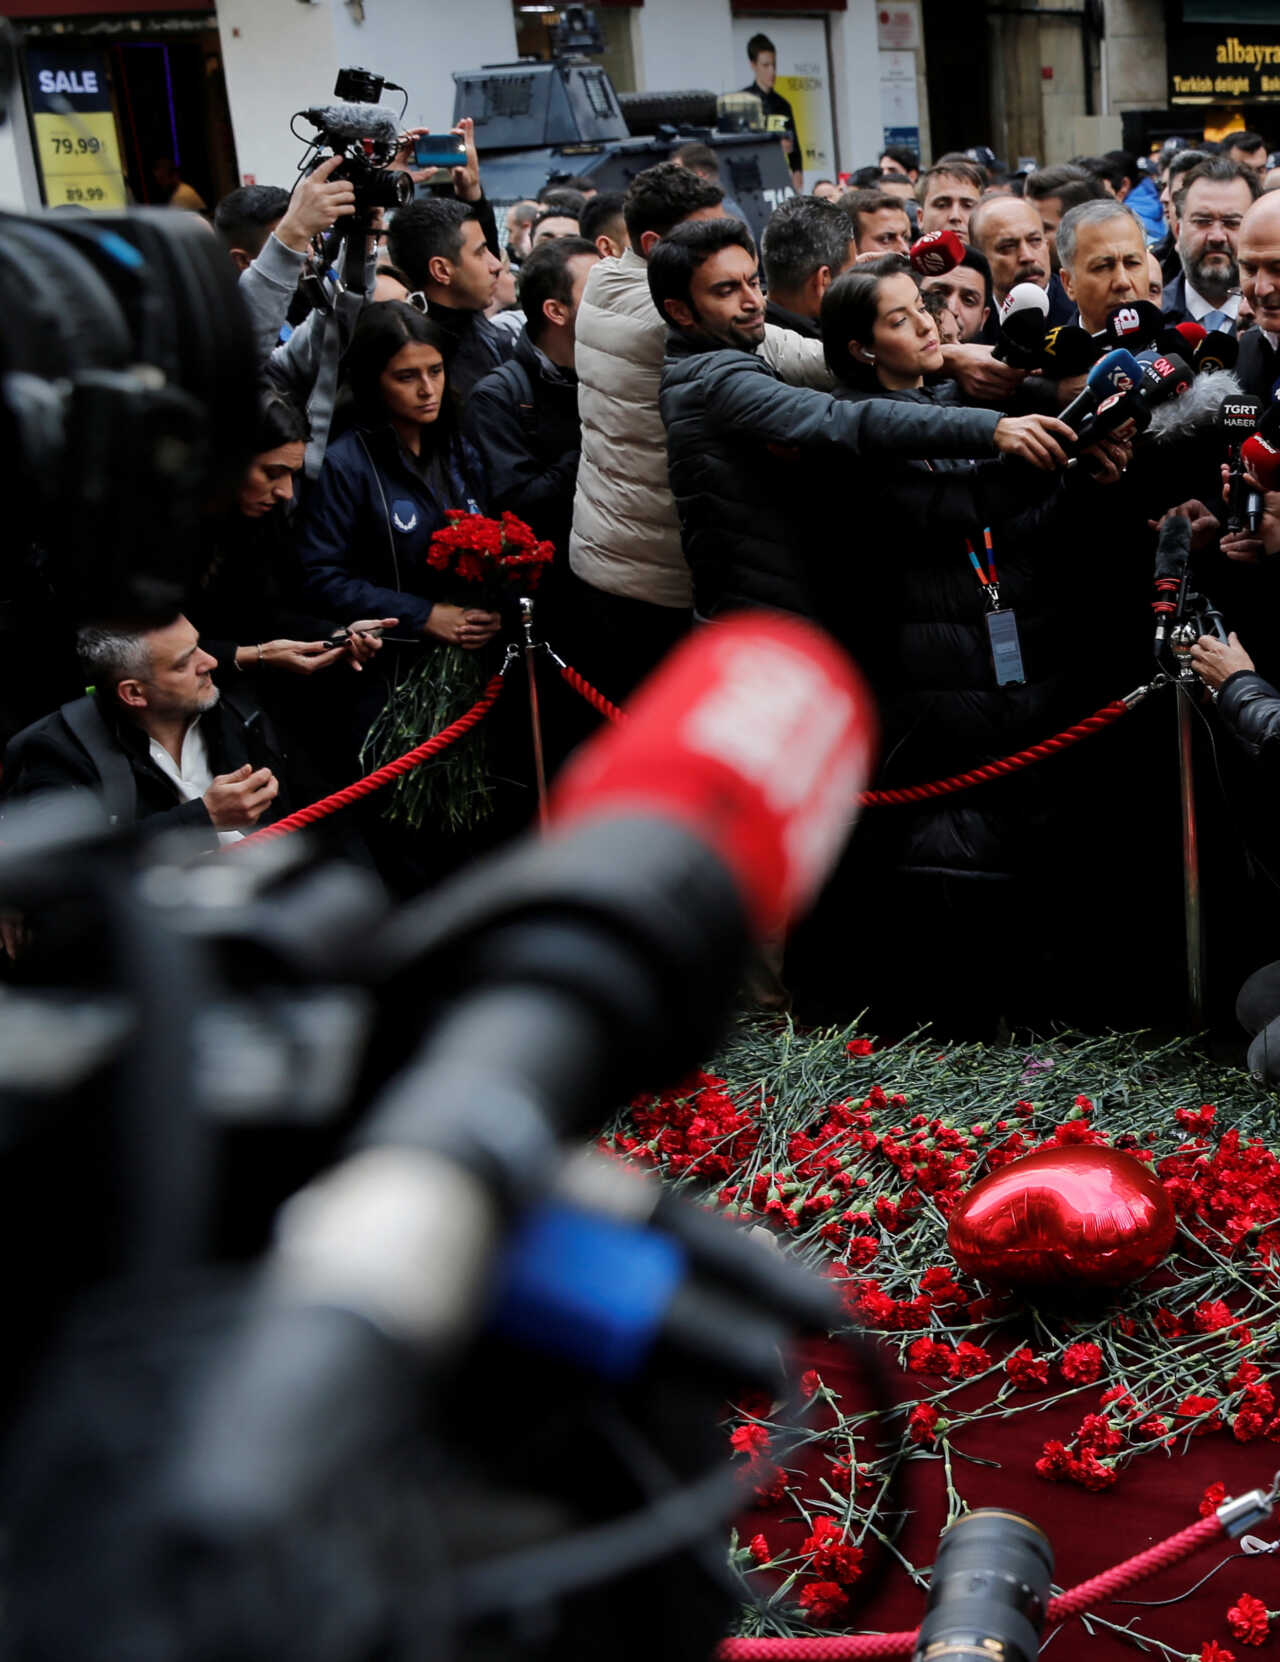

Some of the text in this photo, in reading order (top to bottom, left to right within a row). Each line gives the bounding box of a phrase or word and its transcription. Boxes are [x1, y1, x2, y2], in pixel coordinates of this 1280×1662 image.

[38, 69, 99, 93] SALE
[1173, 76, 1213, 92] Turkish
[1214, 76, 1250, 95] delight
[1224, 404, 1258, 415] TGRT
[1224, 418, 1256, 428] HABER
